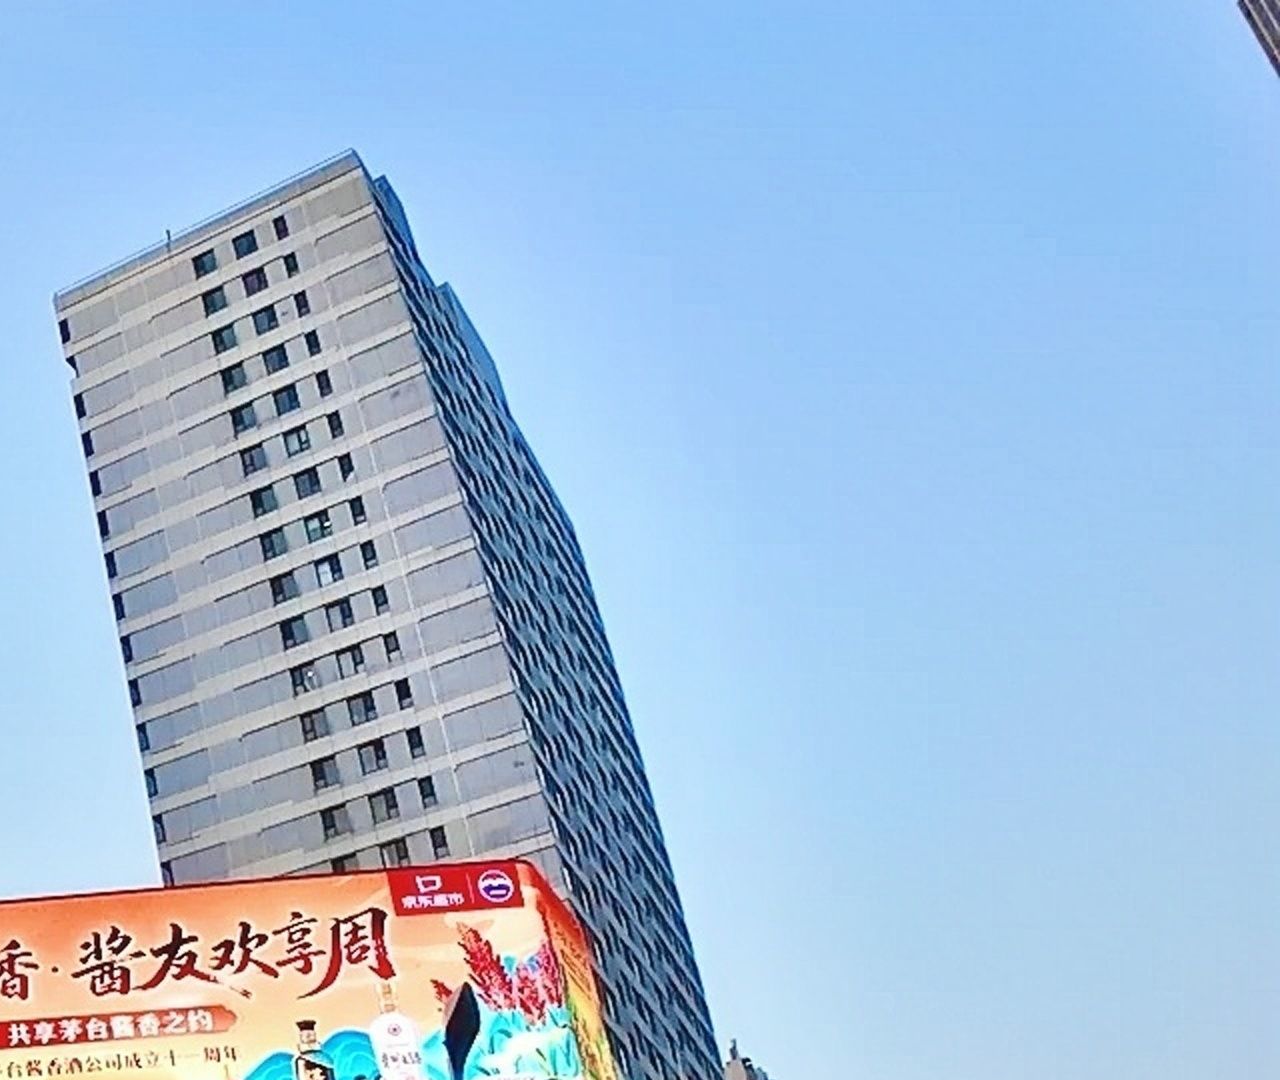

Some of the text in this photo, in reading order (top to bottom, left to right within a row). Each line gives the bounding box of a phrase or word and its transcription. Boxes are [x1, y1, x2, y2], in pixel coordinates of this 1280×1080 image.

[7, 1009, 215, 1047] 共享茅台酱香之约
